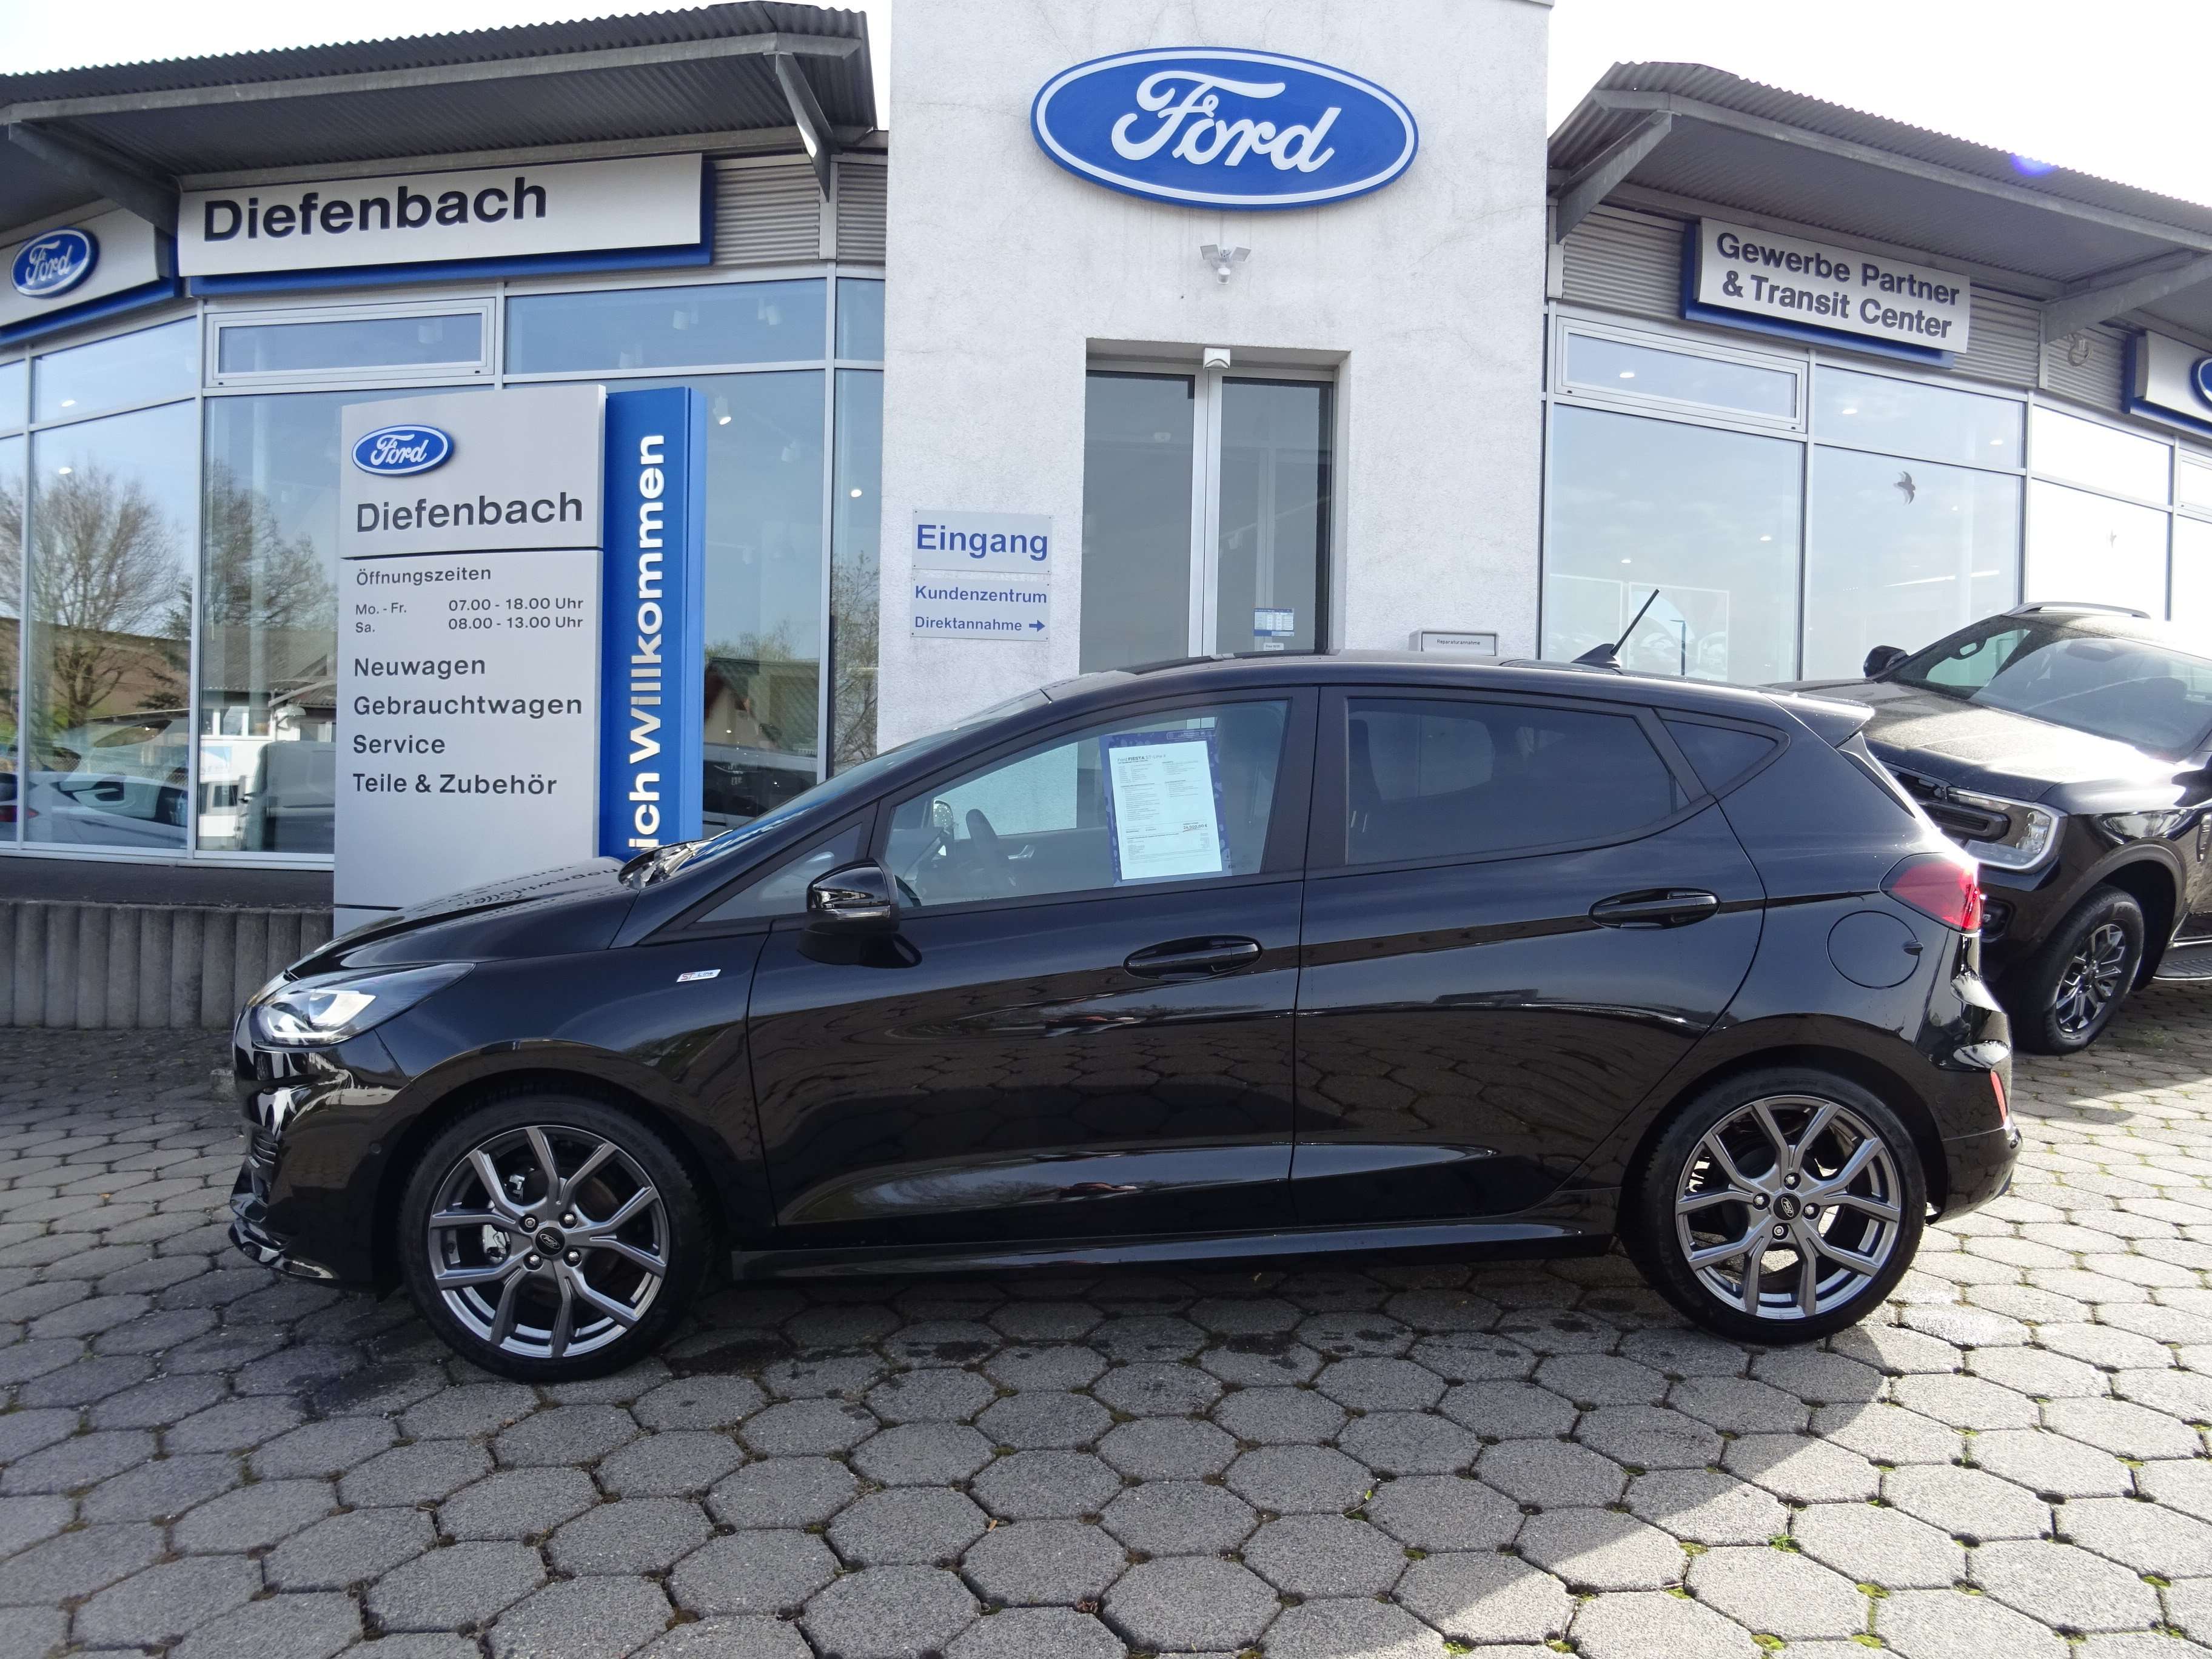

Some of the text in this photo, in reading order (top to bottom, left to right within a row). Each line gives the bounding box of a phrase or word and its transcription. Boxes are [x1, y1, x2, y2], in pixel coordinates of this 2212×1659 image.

[1111, 70, 1342, 173] Ford
[203, 176, 547, 242] Diefenbach
[25, 240, 73, 286] Ford
[1716, 232, 1960, 306] Gewerbe Partner
[1722, 270, 1952, 339] & Transit Center
[370, 434, 427, 466] Ford
[357, 492, 582, 532] Diefenbach
[917, 524, 1048, 561] Eingang
[357, 567, 491, 586] Öffnungszeiten
[355, 603, 379, 615] Mo.
[391, 602, 407, 614] Fr.
[449, 598, 491, 612] 07.00
[506, 597, 551, 610] 18.00
[555, 597, 584, 609] Uhr
[629, 435, 665, 764] Willkommen
[915, 585, 1047, 603] Kundenzentrum
[355, 622, 375, 633] Sa.
[448, 617, 492, 630] 08.00
[507, 616, 551, 629] 13.00
[555, 616, 583, 628] Uhr
[915, 616, 1022, 631] Direktannahme
[354, 658, 485, 680] Neuwagen
[354, 695, 581, 719] Gebrauchtwagen
[353, 734, 445, 754] Service
[352, 773, 557, 795] Teile & Zubehör
